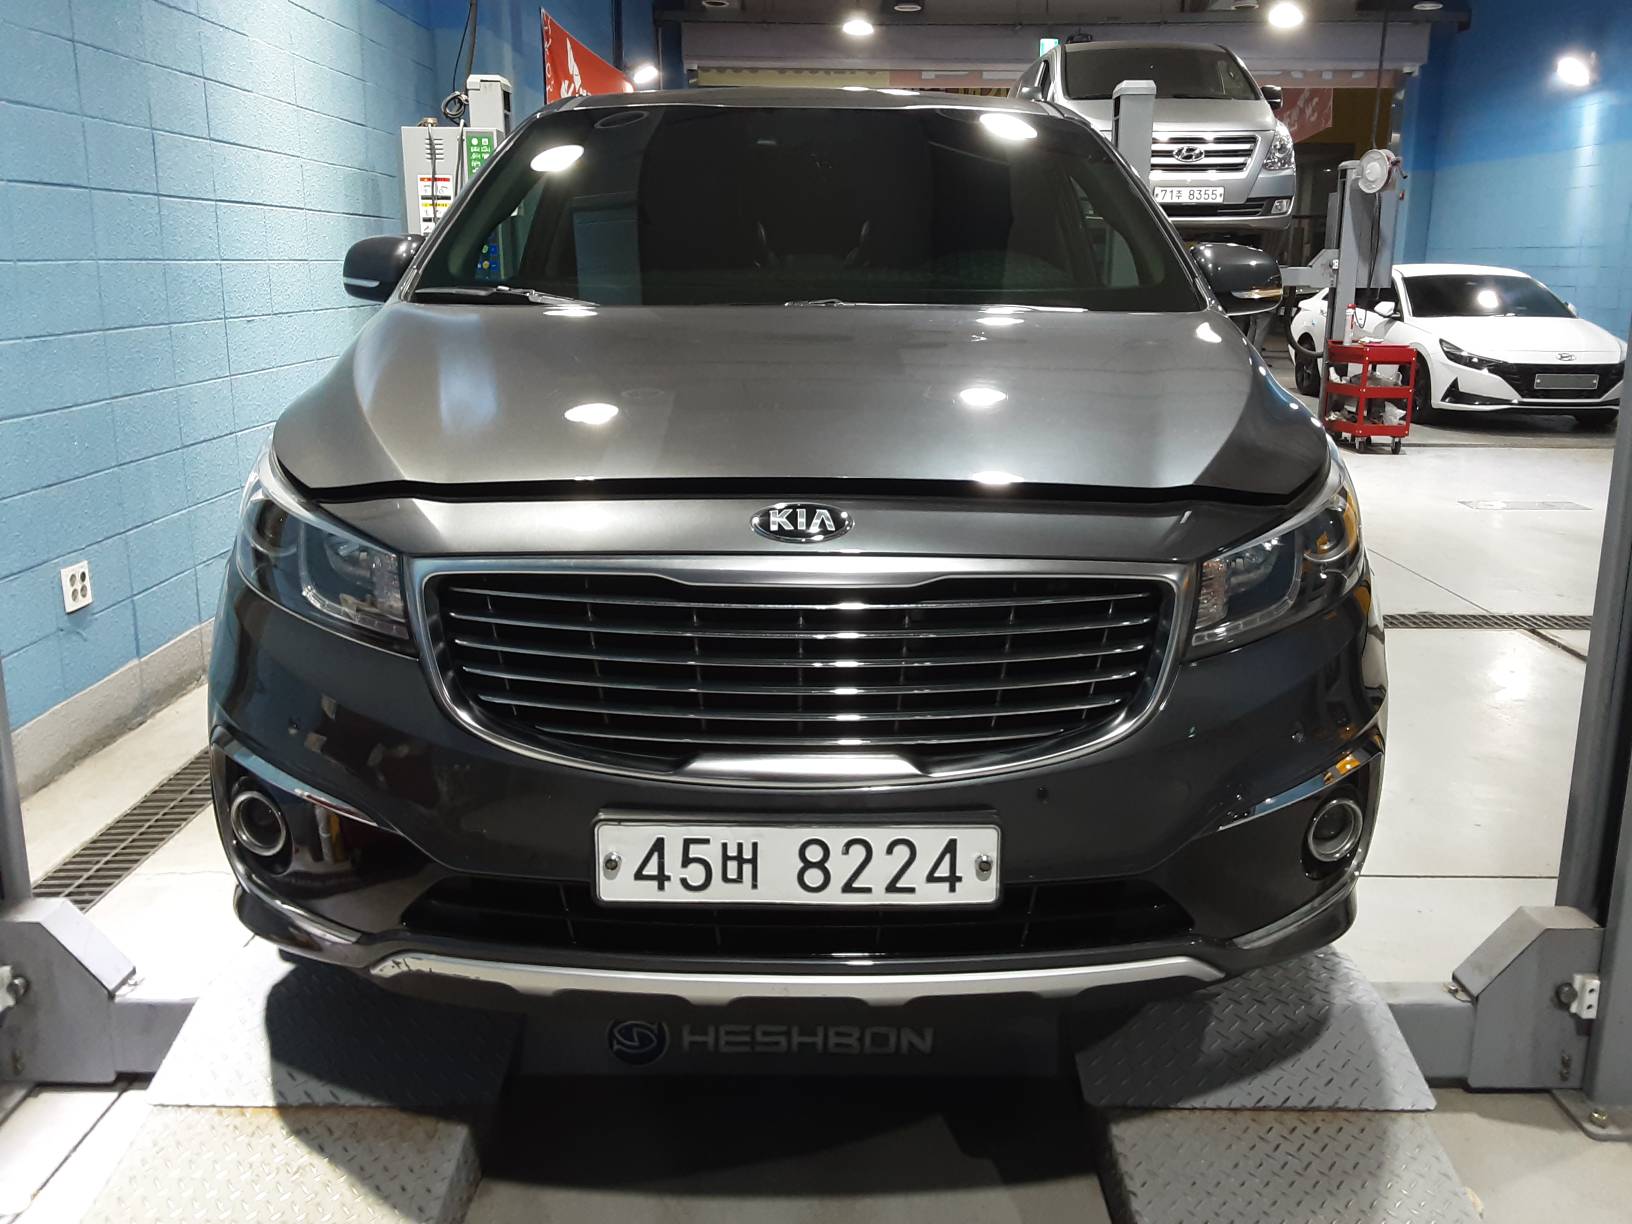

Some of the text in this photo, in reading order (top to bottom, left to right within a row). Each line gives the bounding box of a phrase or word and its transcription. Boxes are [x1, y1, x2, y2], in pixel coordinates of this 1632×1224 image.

[1160, 189, 1218, 201] 71주 8355
[768, 508, 836, 532] KIA
[633, 835, 963, 895] 45버 8224
[682, 1024, 934, 1054] HESHBON
